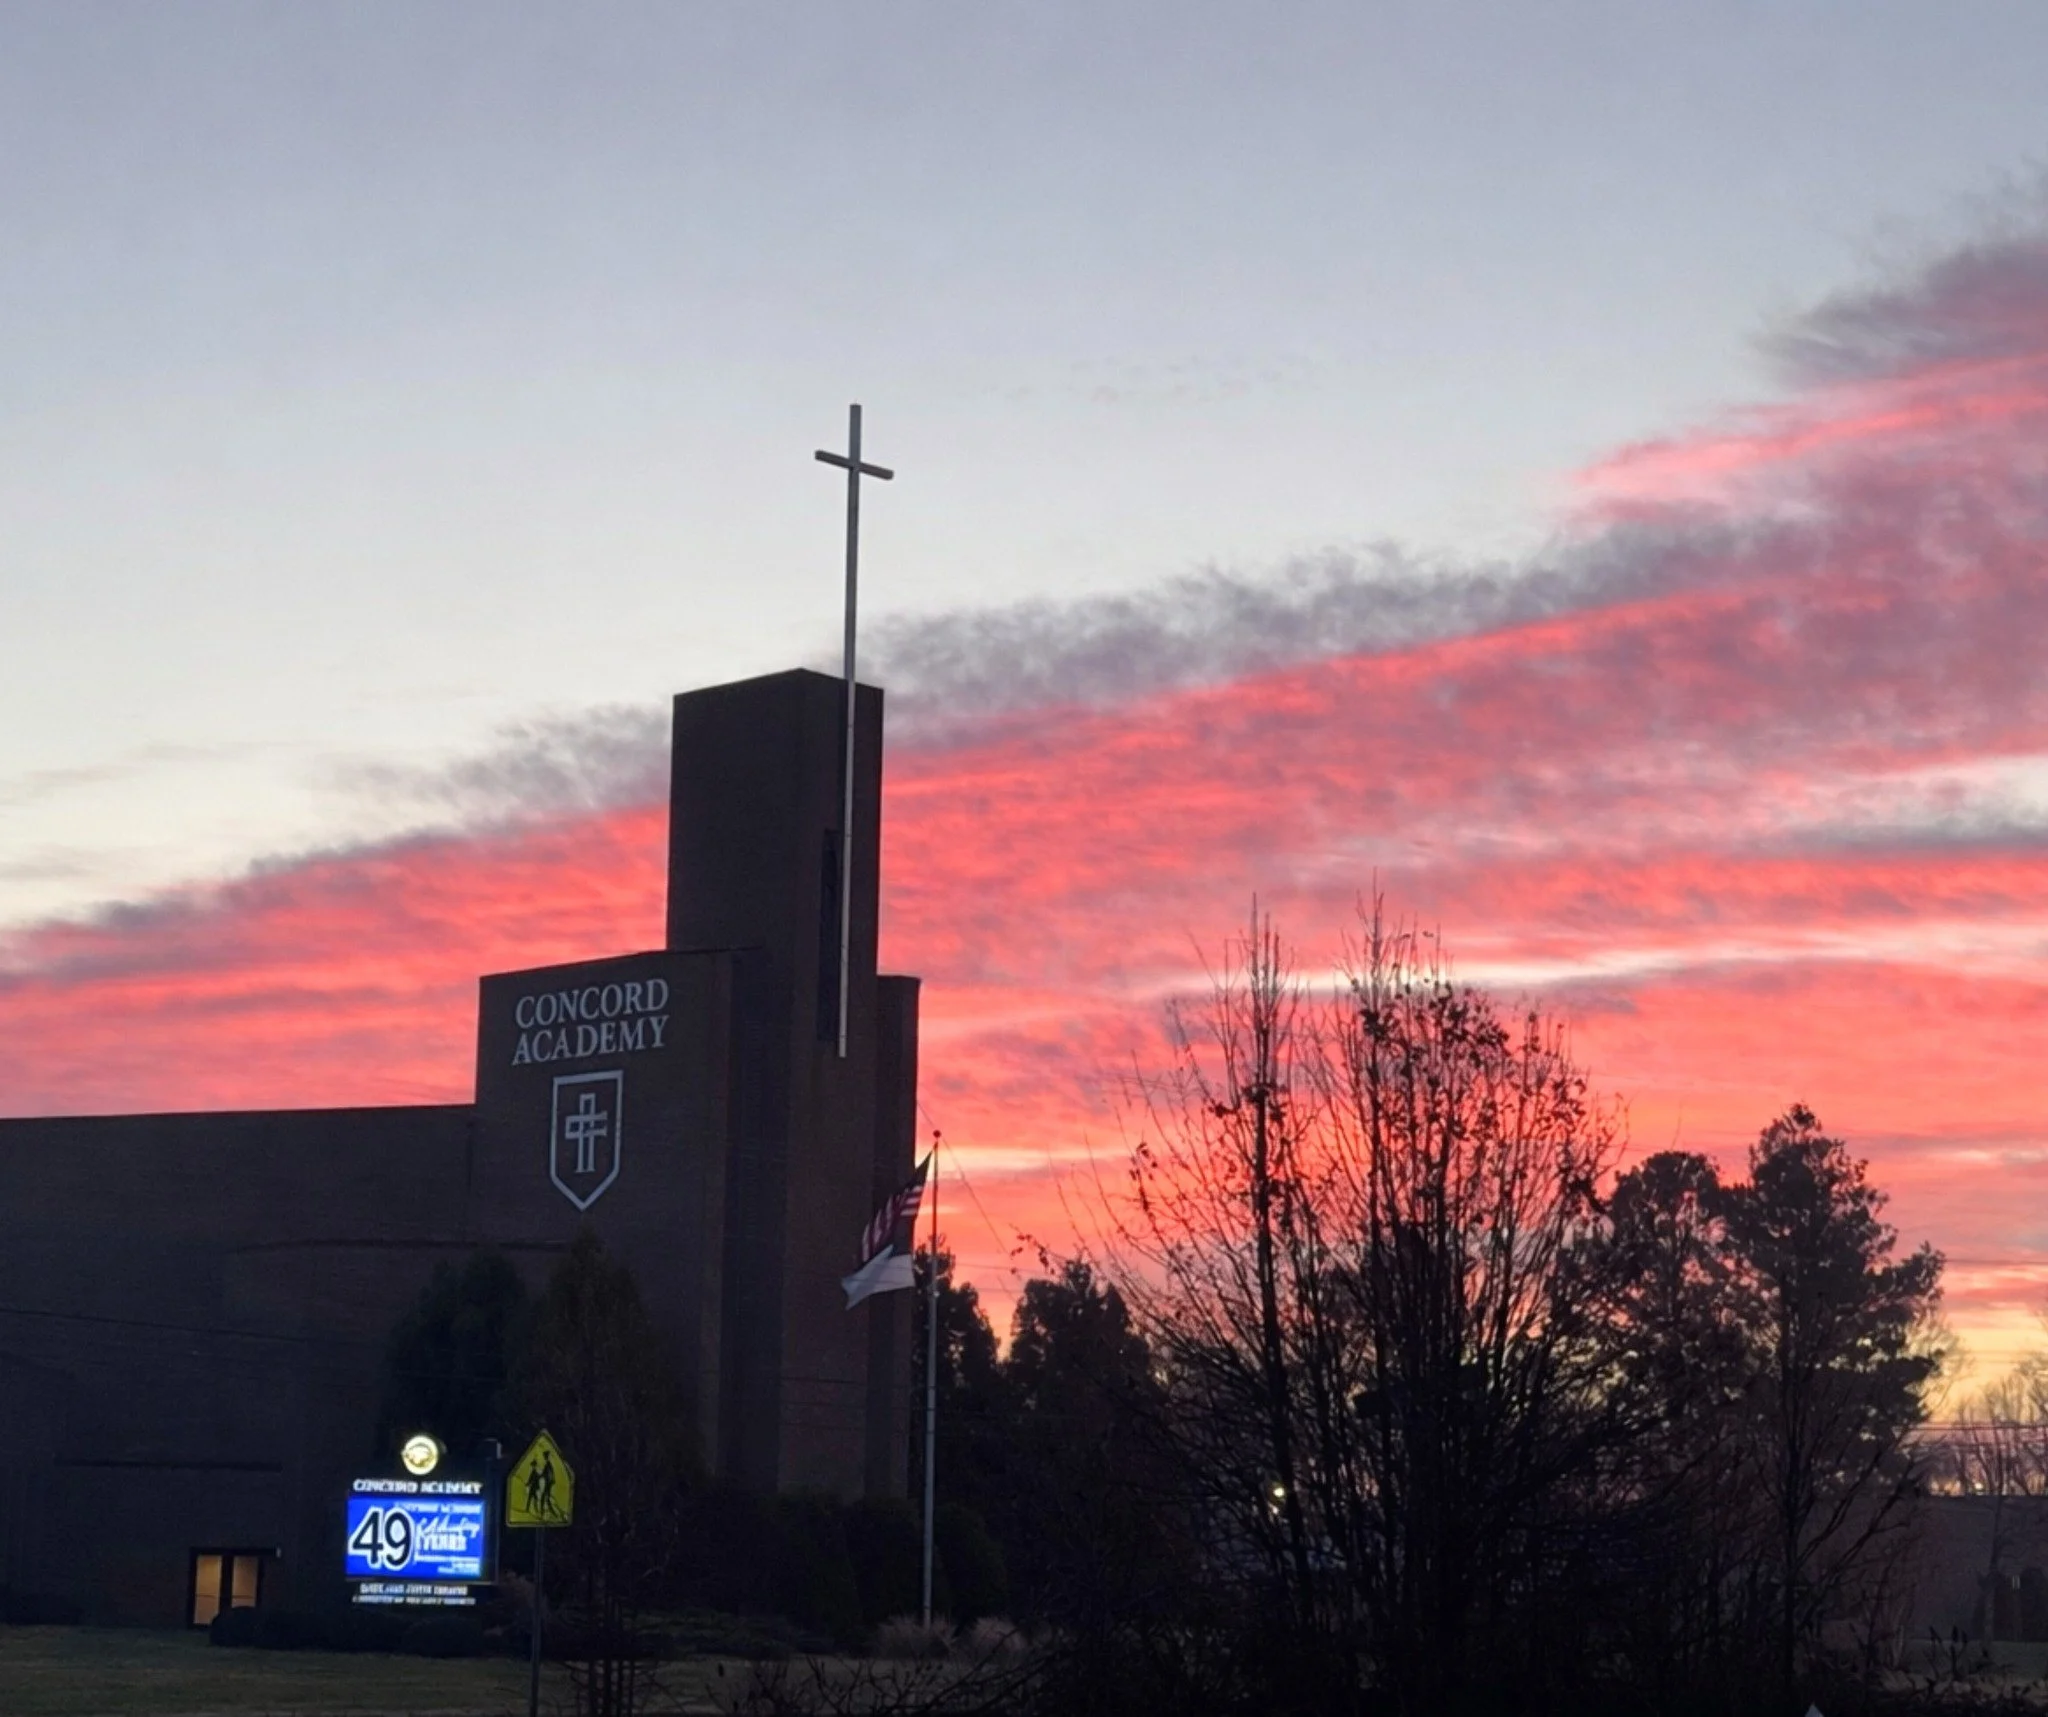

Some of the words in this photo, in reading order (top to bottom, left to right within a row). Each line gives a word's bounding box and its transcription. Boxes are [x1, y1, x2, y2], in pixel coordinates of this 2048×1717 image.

[515, 978, 669, 1028] CONCORD
[511, 1015, 669, 1066] ACADEMY
[348, 1507, 414, 1570] 49
